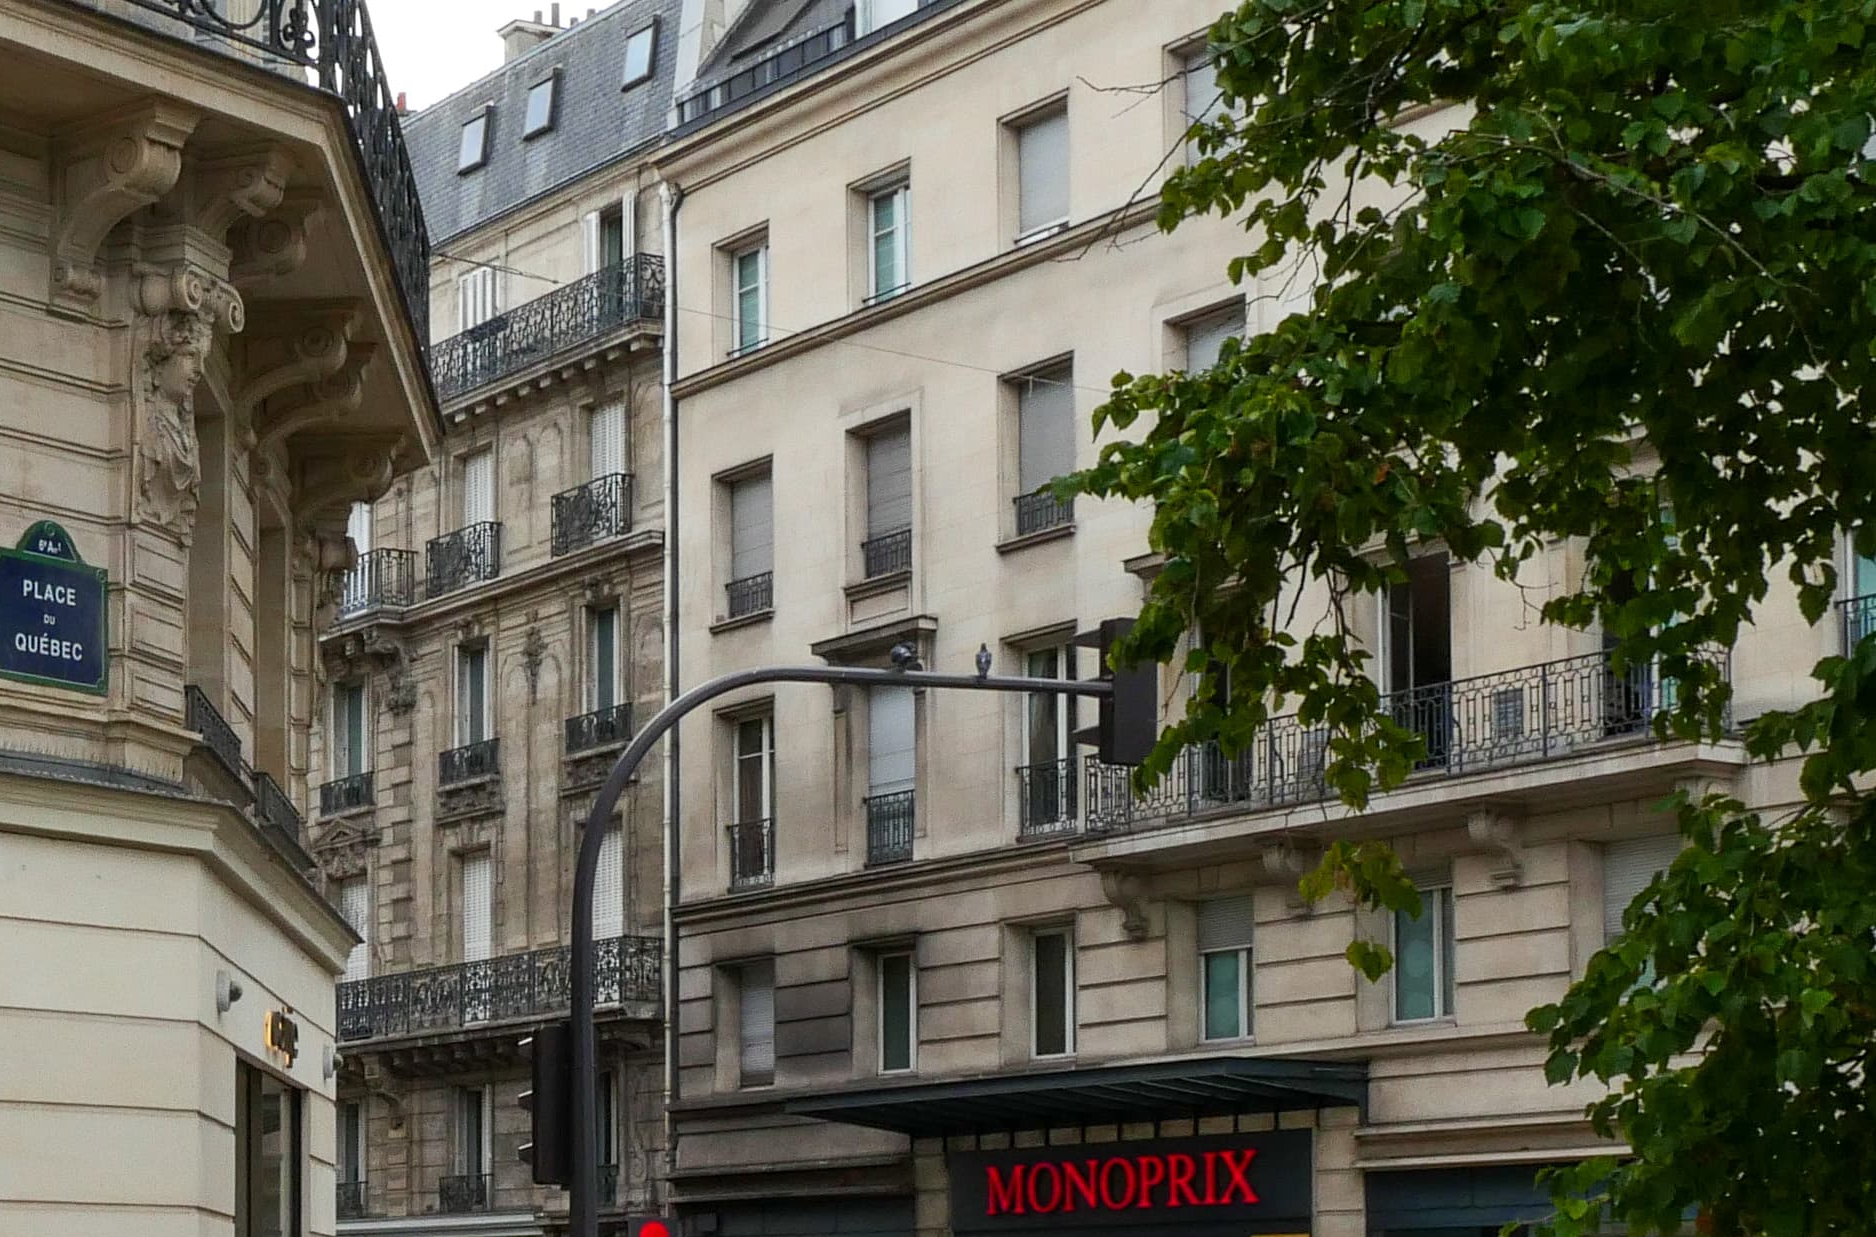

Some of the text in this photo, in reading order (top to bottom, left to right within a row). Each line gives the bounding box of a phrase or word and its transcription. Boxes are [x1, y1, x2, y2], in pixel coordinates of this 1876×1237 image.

[22, 579, 77, 606] PLACE
[43, 613, 56, 625] DU
[15, 632, 83, 661] QUÉBEC
[985, 1149, 1260, 1217] MONOPRIX
